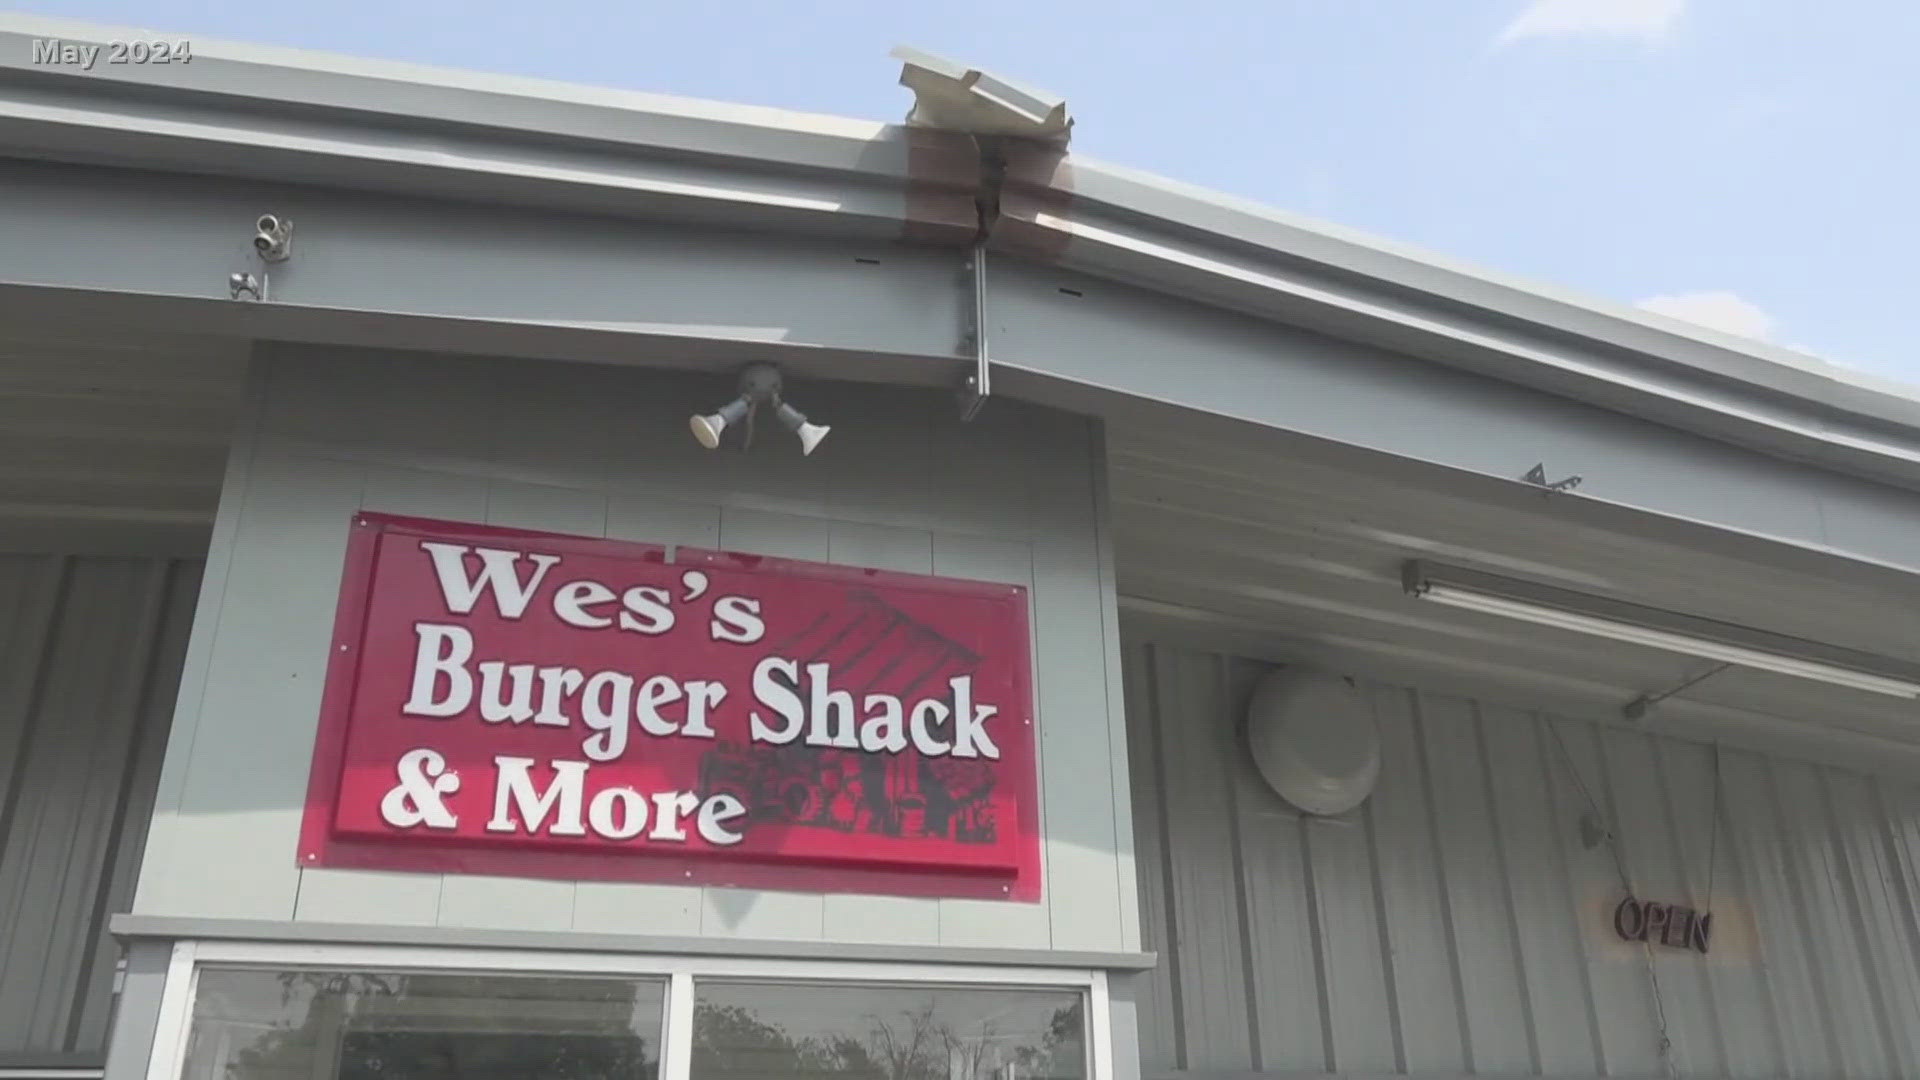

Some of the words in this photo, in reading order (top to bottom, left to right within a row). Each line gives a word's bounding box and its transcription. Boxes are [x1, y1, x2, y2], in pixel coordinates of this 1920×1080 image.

[419, 541, 766, 644] Wes's
[402, 622, 729, 762] Burger
[749, 656, 1000, 760] Shack
[380, 748, 461, 830] &
[486, 755, 747, 845] More
[1614, 896, 1711, 954] OPEN
